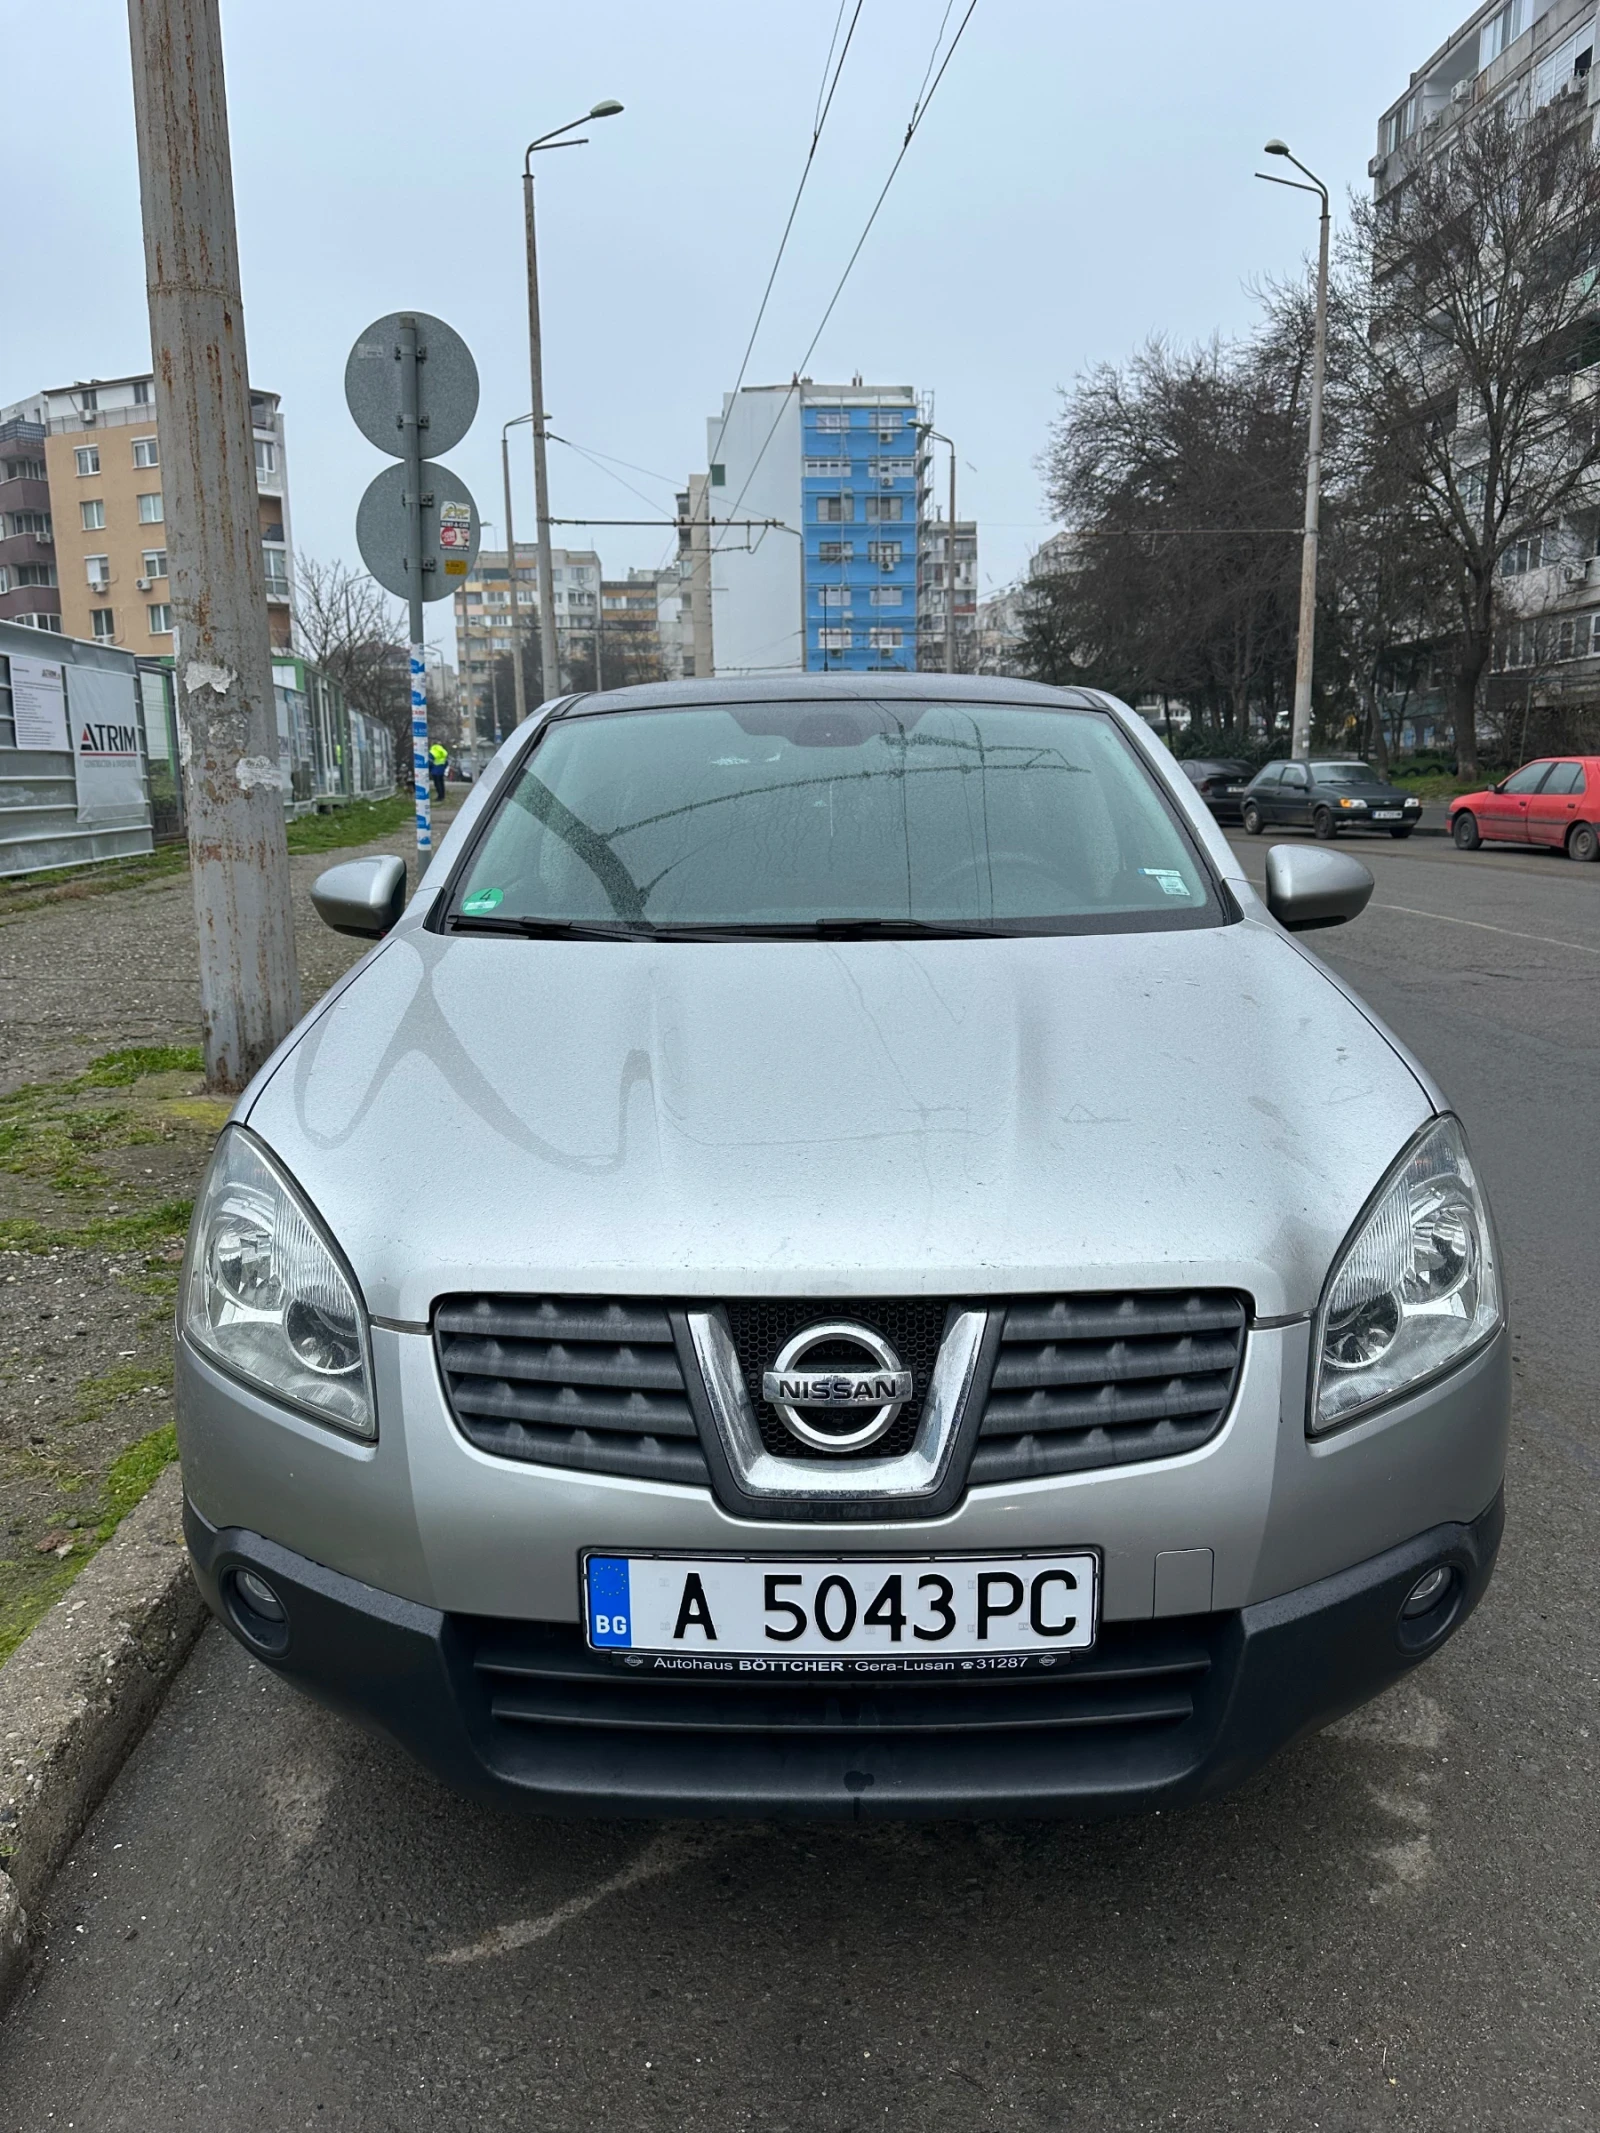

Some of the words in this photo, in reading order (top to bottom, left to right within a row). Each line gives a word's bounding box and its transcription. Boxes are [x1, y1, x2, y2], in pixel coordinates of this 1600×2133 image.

[80, 723, 137, 752] ATRIM
[479, 888, 493, 902] 4
[779, 1379, 897, 1400] NISSAN
[673, 1572, 718, 1640] A
[595, 1614, 627, 1635] BG
[654, 1656, 734, 1671] Autohaus
[739, 1658, 844, 1672] BÖTTCHER
[855, 1660, 955, 1672] Gera-Lusan
[976, 1657, 1029, 1670] 31287
